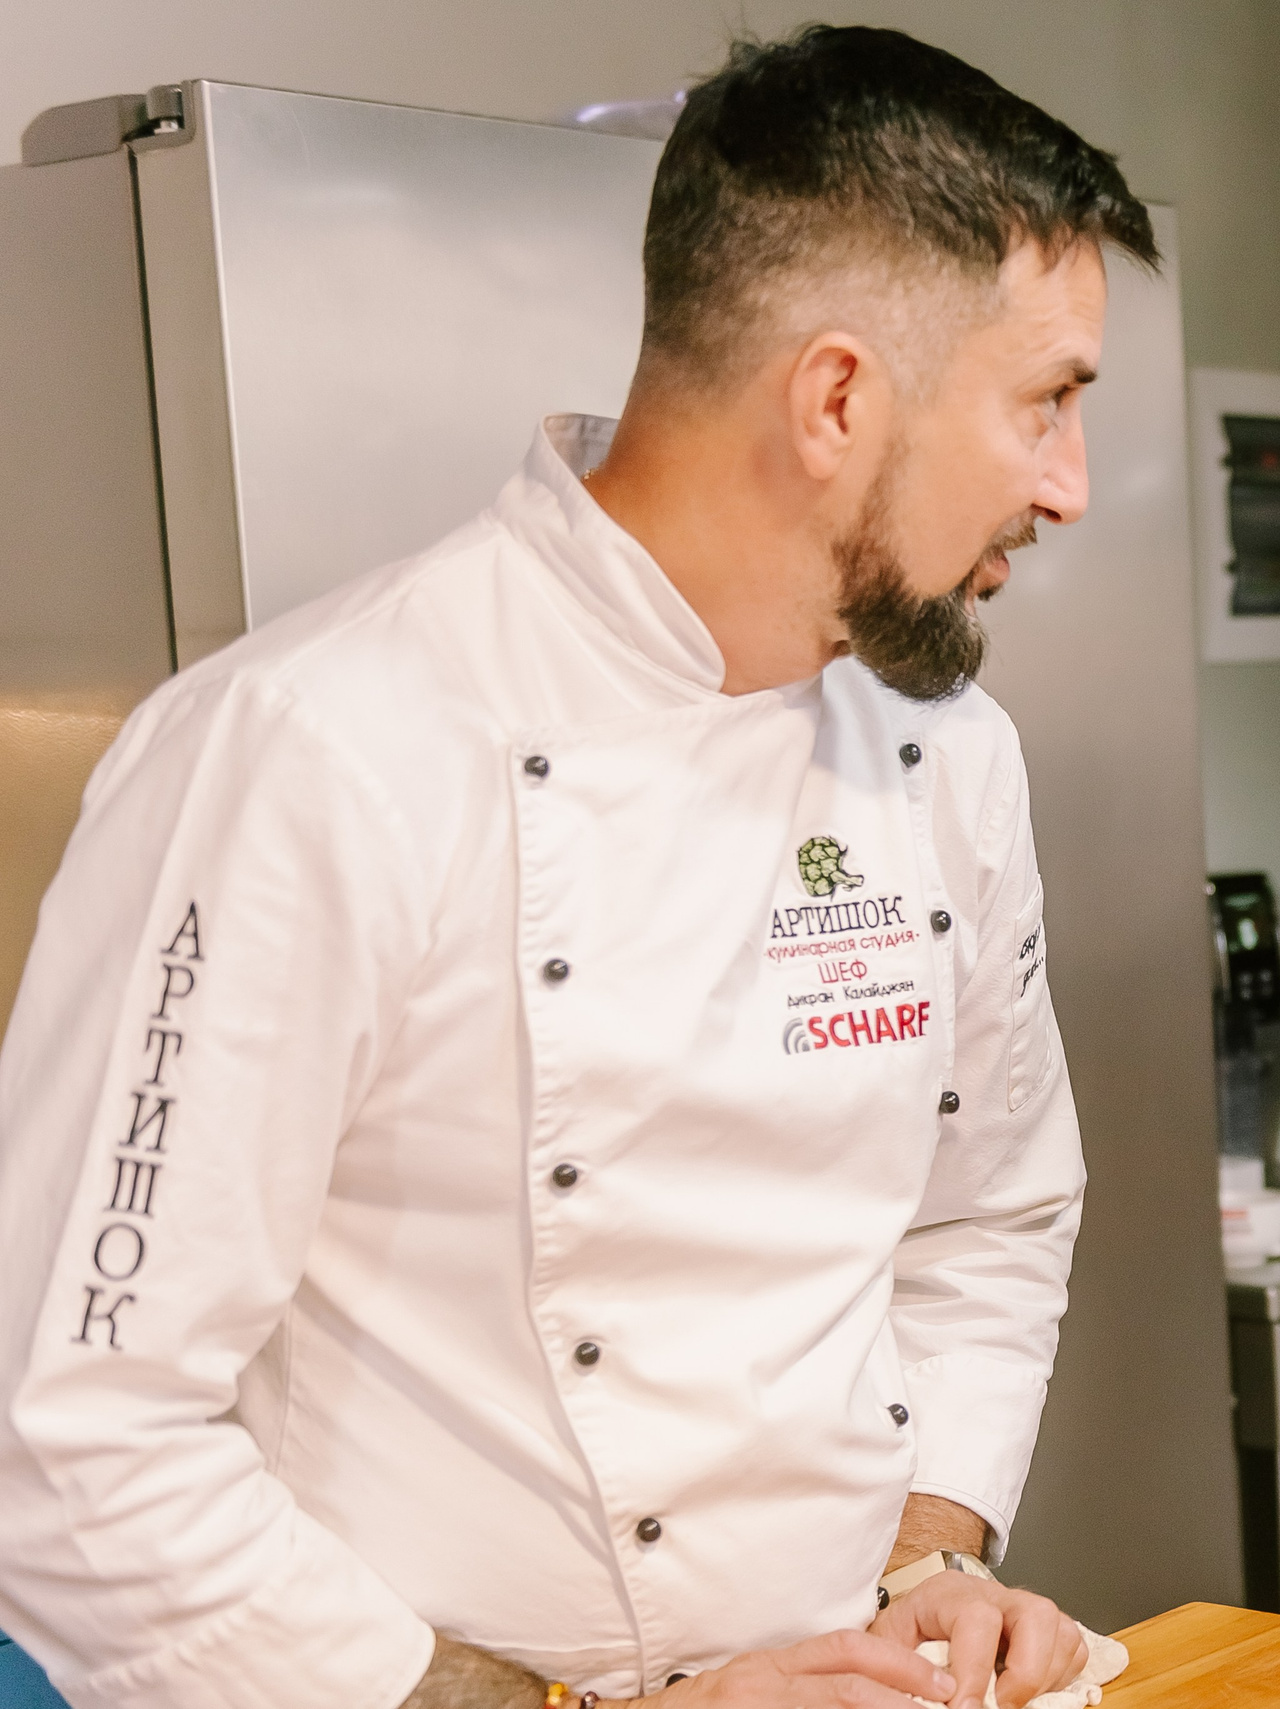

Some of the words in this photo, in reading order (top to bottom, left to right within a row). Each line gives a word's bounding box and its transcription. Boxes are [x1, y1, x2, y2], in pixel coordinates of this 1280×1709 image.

[770, 896, 906, 939] АРТИШОК
[818, 959, 867, 984] ШЕФ
[808, 1001, 930, 1049] SCHARF
[71, 900, 204, 1350] АРТИШОК
